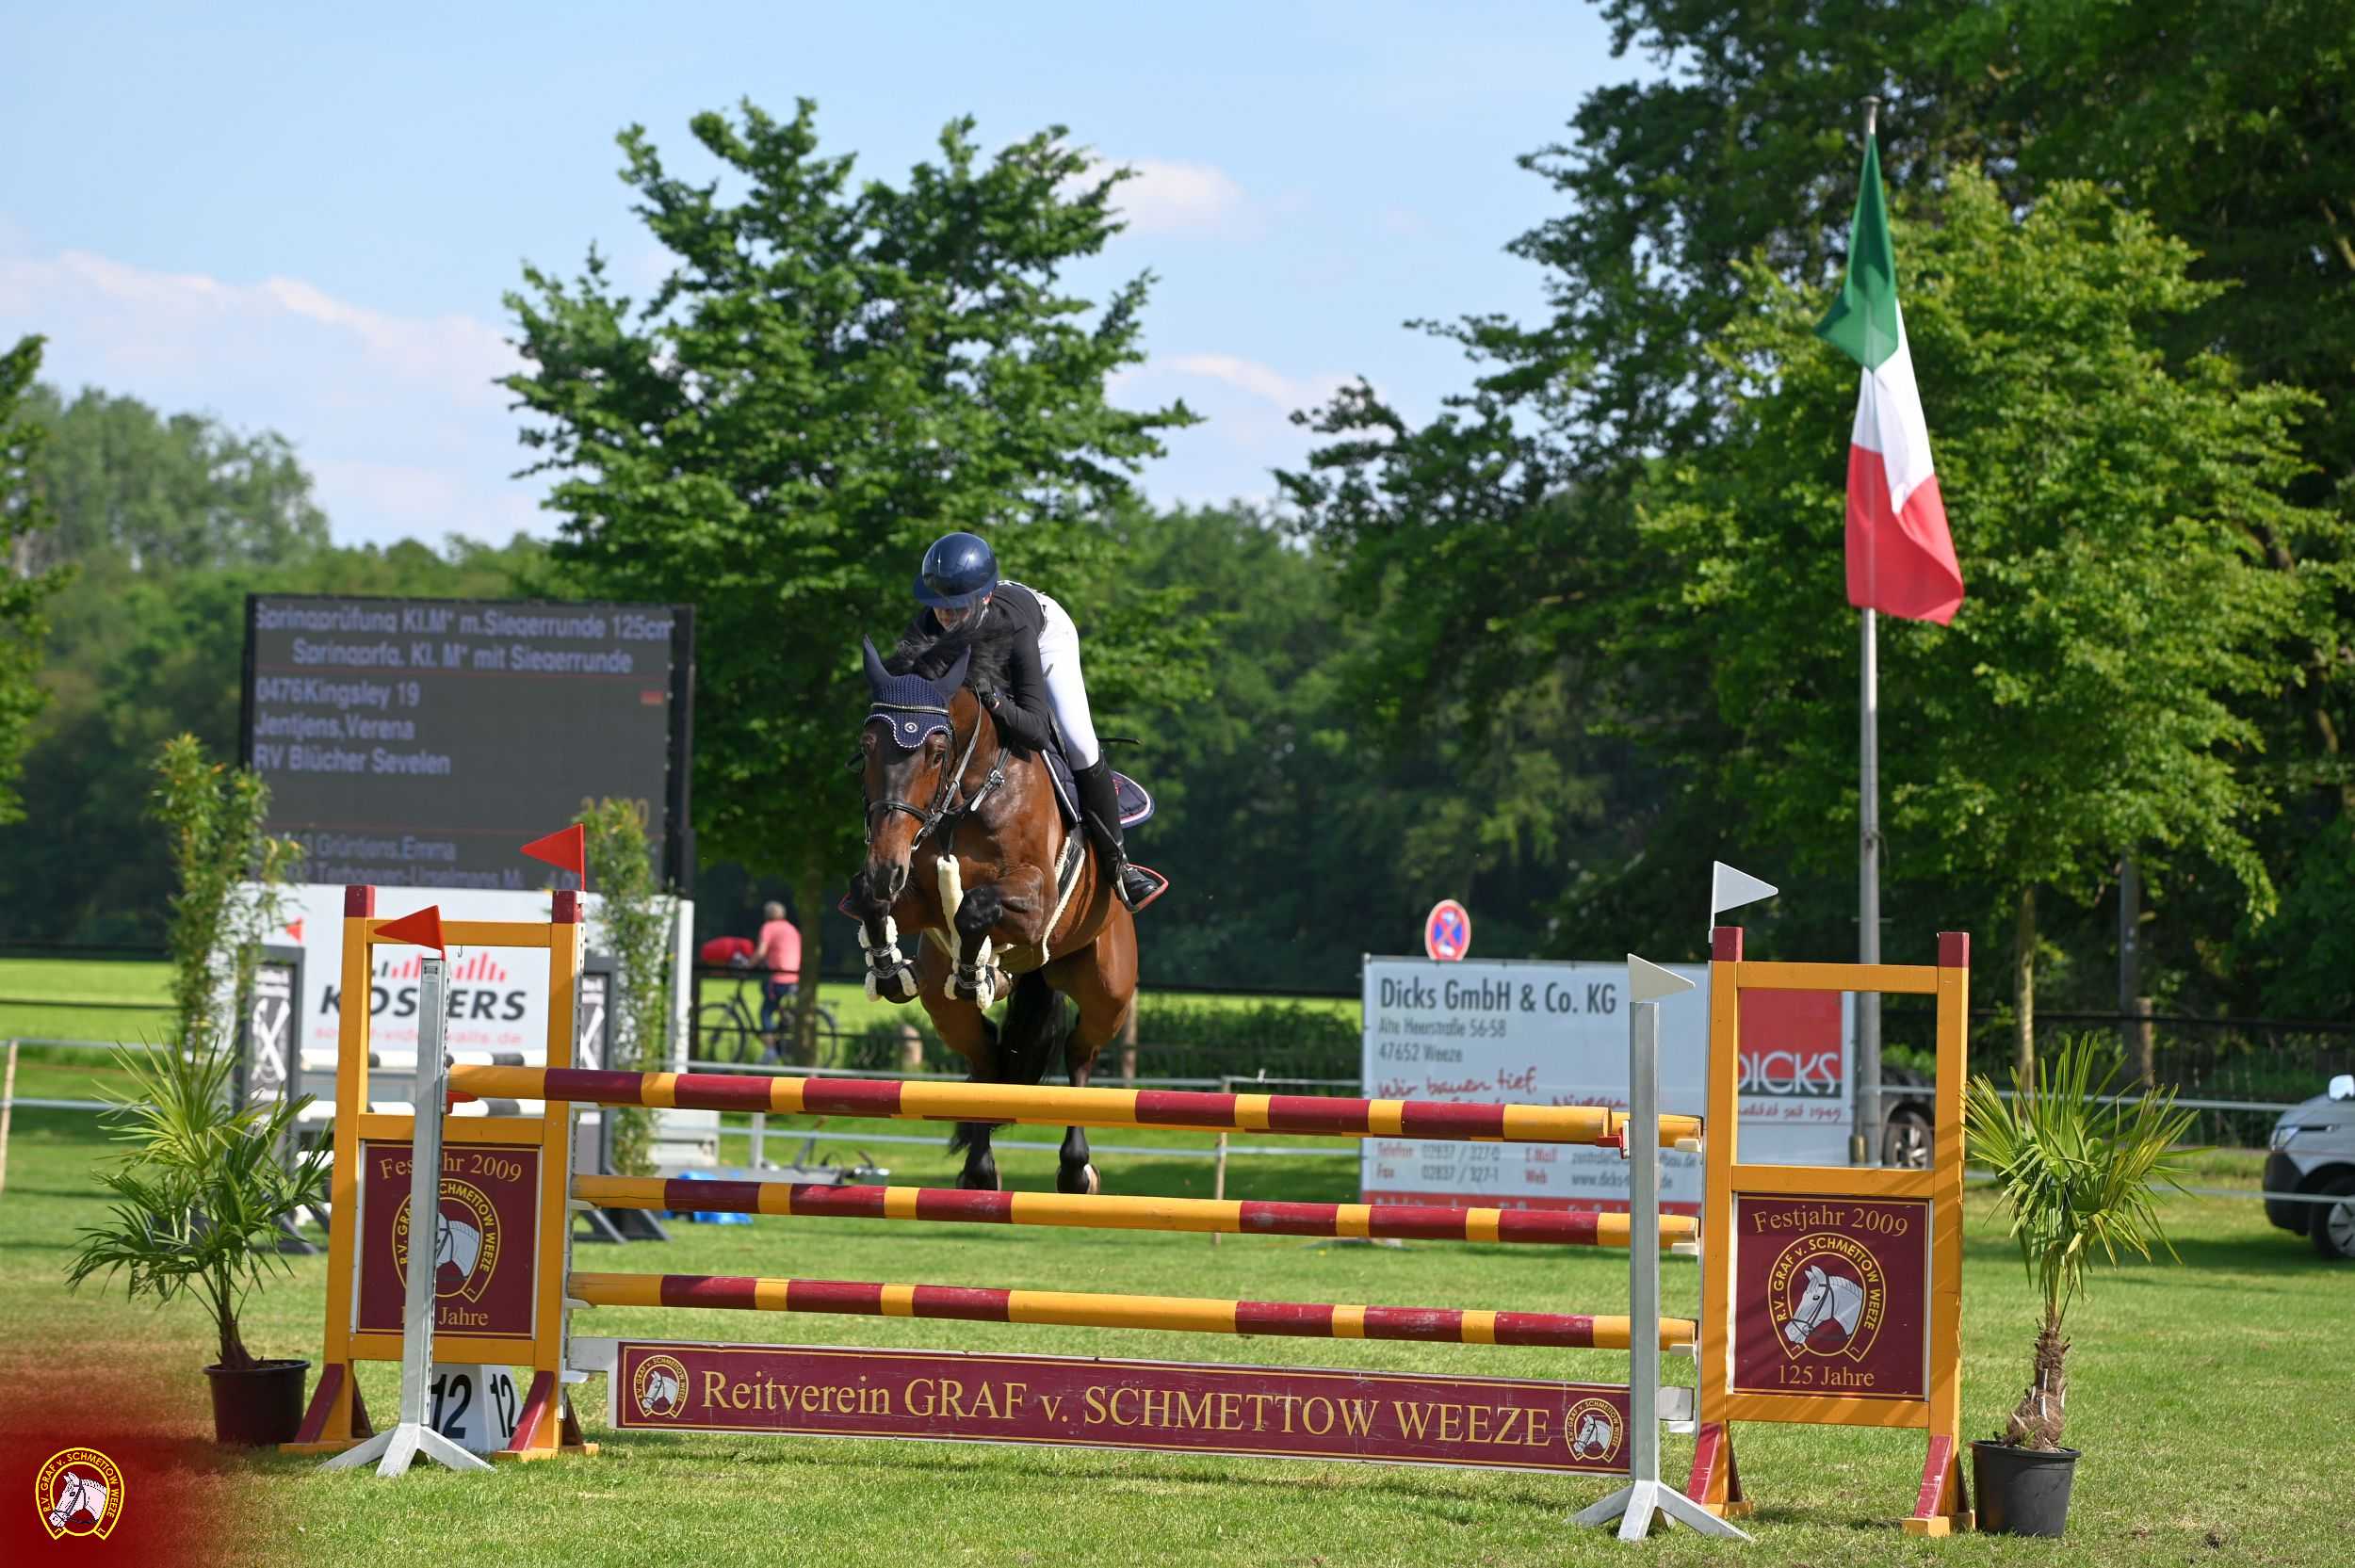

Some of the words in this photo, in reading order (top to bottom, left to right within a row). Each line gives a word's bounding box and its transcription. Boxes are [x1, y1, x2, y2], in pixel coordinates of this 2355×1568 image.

[474, 644, 505, 670] mit
[397, 681, 421, 706] 19
[253, 744, 283, 769] RV
[289, 745, 366, 772] Blücher
[372, 747, 452, 775] Sevelen
[1380, 977, 1437, 1009] Dicks
[1445, 978, 1511, 1011] GmbH
[1519, 983, 1536, 1011] &
[1545, 982, 1579, 1014] Co.
[1587, 983, 1616, 1014] KG
[1470, 1019, 1507, 1038] 56-58
[1379, 1042, 1418, 1061] 47652
[1422, 1044, 1463, 1063] Weeze
[1378, 1078, 1417, 1098] Wir
[1426, 1076, 1491, 1096] bauen
[380, 1152, 465, 1179] Feshr
[470, 1154, 522, 1183] 2009
[1376, 1163, 1394, 1178] Fax
[1524, 1169, 1548, 1186] Web
[440, 1183, 495, 1226] CHMETTOW
[479, 1232, 496, 1271] WEEZE
[1752, 1204, 1845, 1233] Festjahr
[1852, 1207, 1908, 1237] 2009
[1774, 1255, 1795, 1291] GRAF
[1809, 1237, 1879, 1283] SCHMETTOW
[1863, 1288, 1882, 1331] WEEZE
[438, 1307, 489, 1326] Jahre
[1778, 1365, 1813, 1384] 125
[1821, 1366, 1875, 1386] Jahre
[430, 1374, 473, 1439] 12
[490, 1373, 517, 1438] 12
[701, 1370, 891, 1415] Reitverein
[904, 1378, 1027, 1420] GRAF
[1040, 1395, 1068, 1423] v.
[1084, 1385, 1381, 1436] SCHMETTOW
[1393, 1399, 1551, 1447] WEEZE
